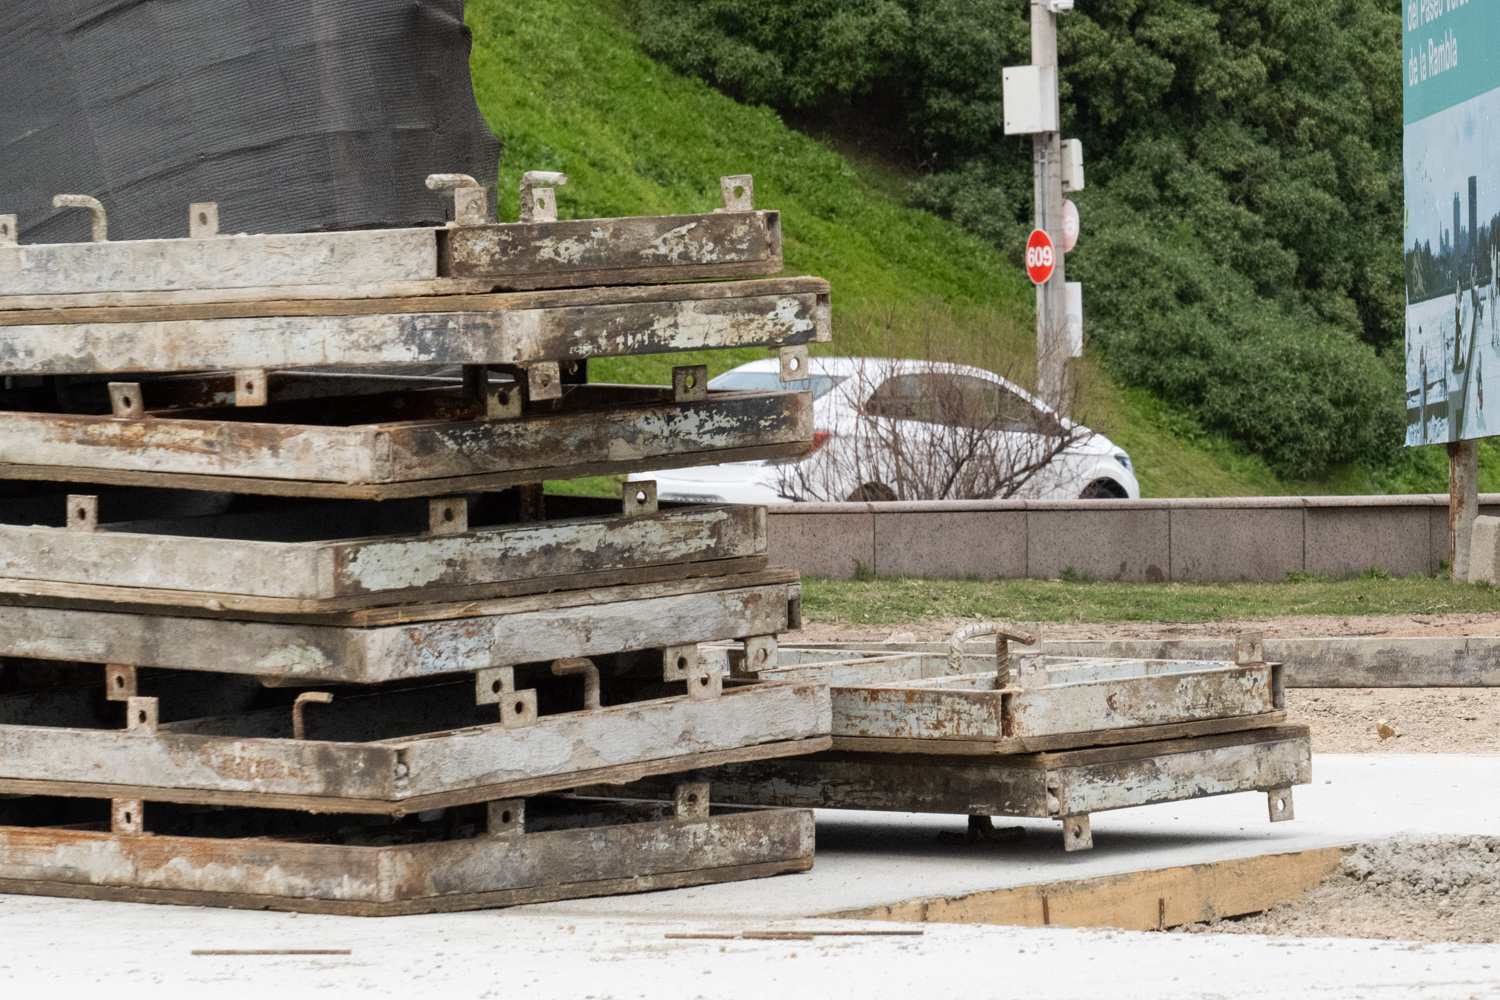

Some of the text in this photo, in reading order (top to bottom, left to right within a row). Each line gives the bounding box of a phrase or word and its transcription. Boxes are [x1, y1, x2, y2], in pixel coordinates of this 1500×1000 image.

[1408, 28, 1458, 87] de la Rambla
[1027, 245, 1053, 268] 609
